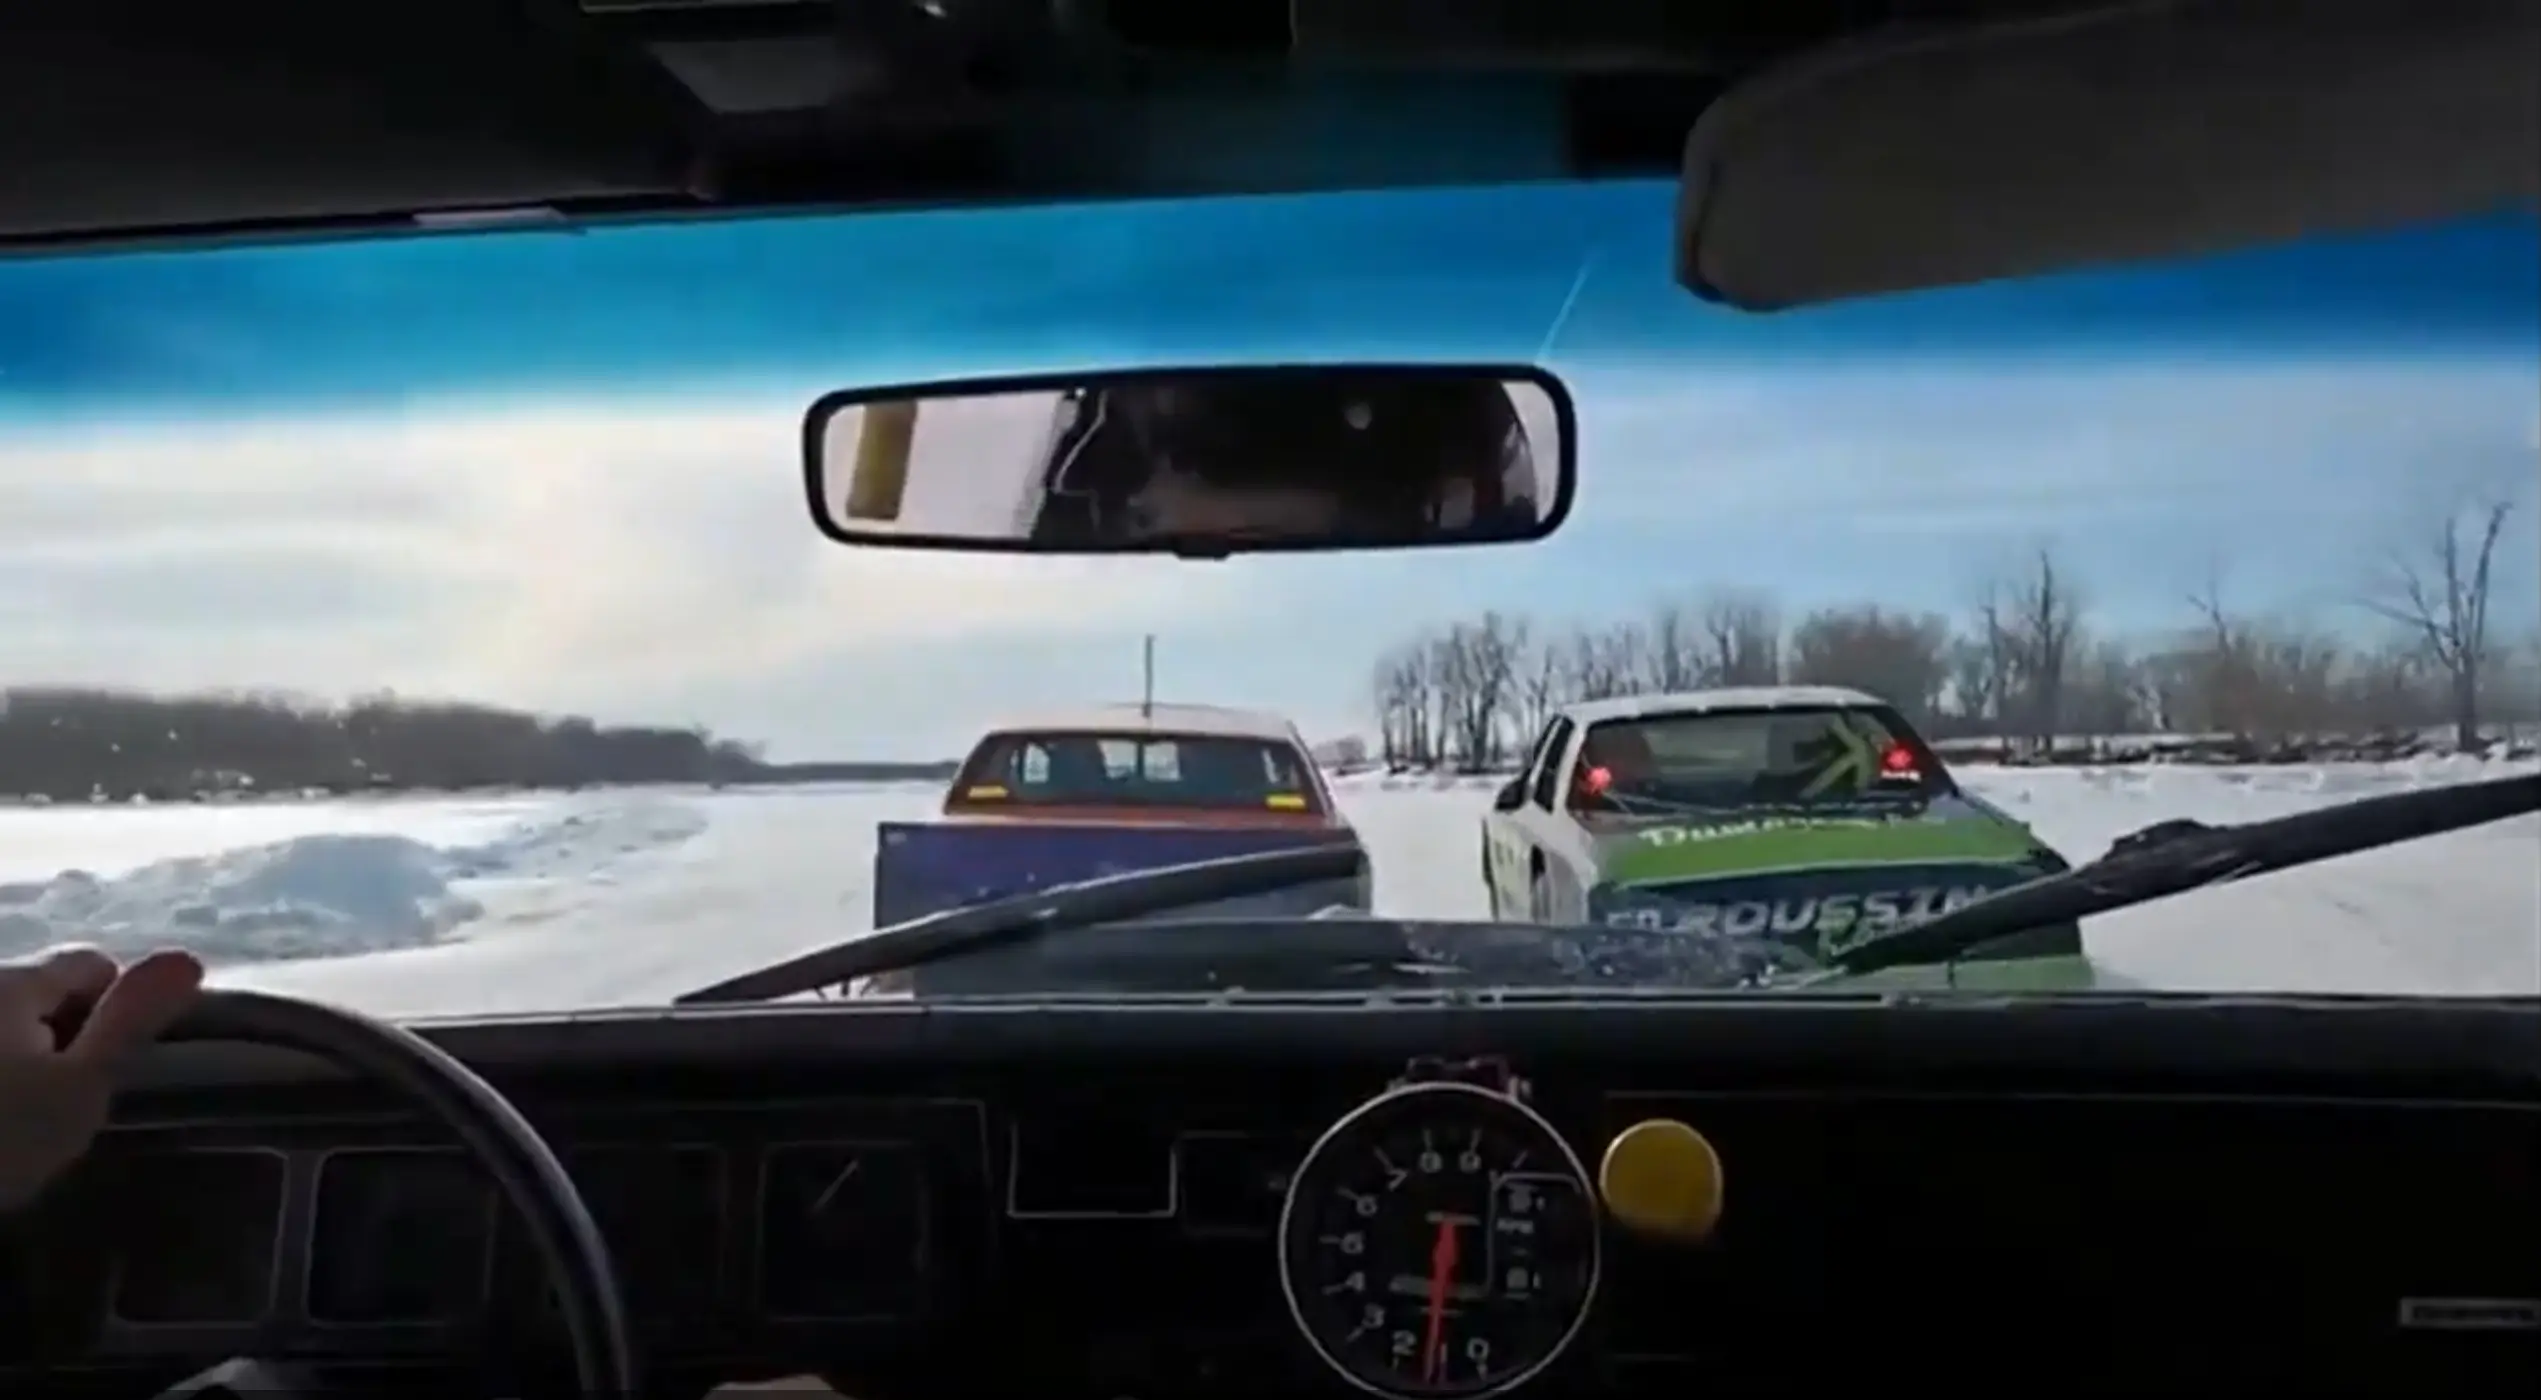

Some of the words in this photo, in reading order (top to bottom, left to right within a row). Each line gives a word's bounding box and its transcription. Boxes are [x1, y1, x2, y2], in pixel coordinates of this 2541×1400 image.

[1361, 1302, 1385, 1329] 3
[1392, 1329, 1417, 1356] 2
[1466, 1337, 1490, 1361] 0
